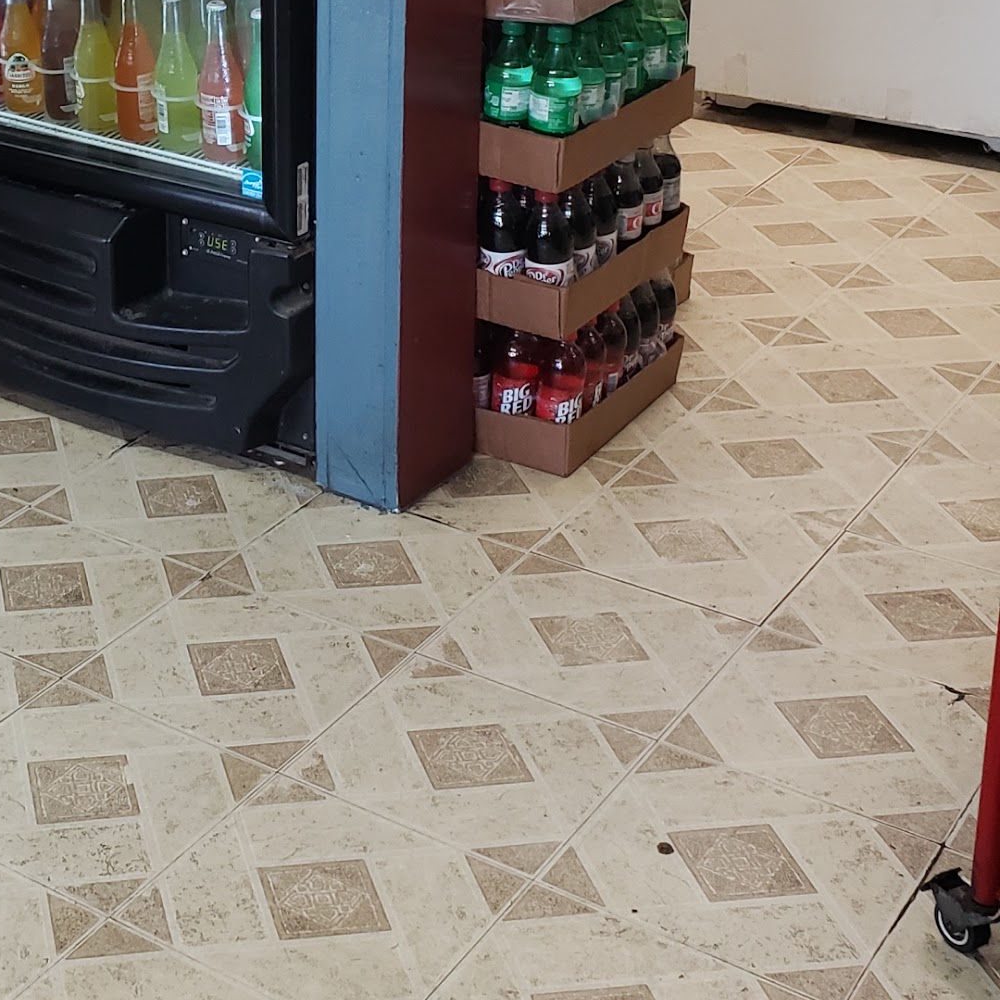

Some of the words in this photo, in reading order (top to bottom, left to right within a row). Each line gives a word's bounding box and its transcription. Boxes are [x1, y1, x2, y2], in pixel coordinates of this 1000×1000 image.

[206, 235, 228, 251] USE
[502, 383, 531, 404] BIG
[501, 396, 532, 414] RED
[557, 391, 583, 417] BIG
